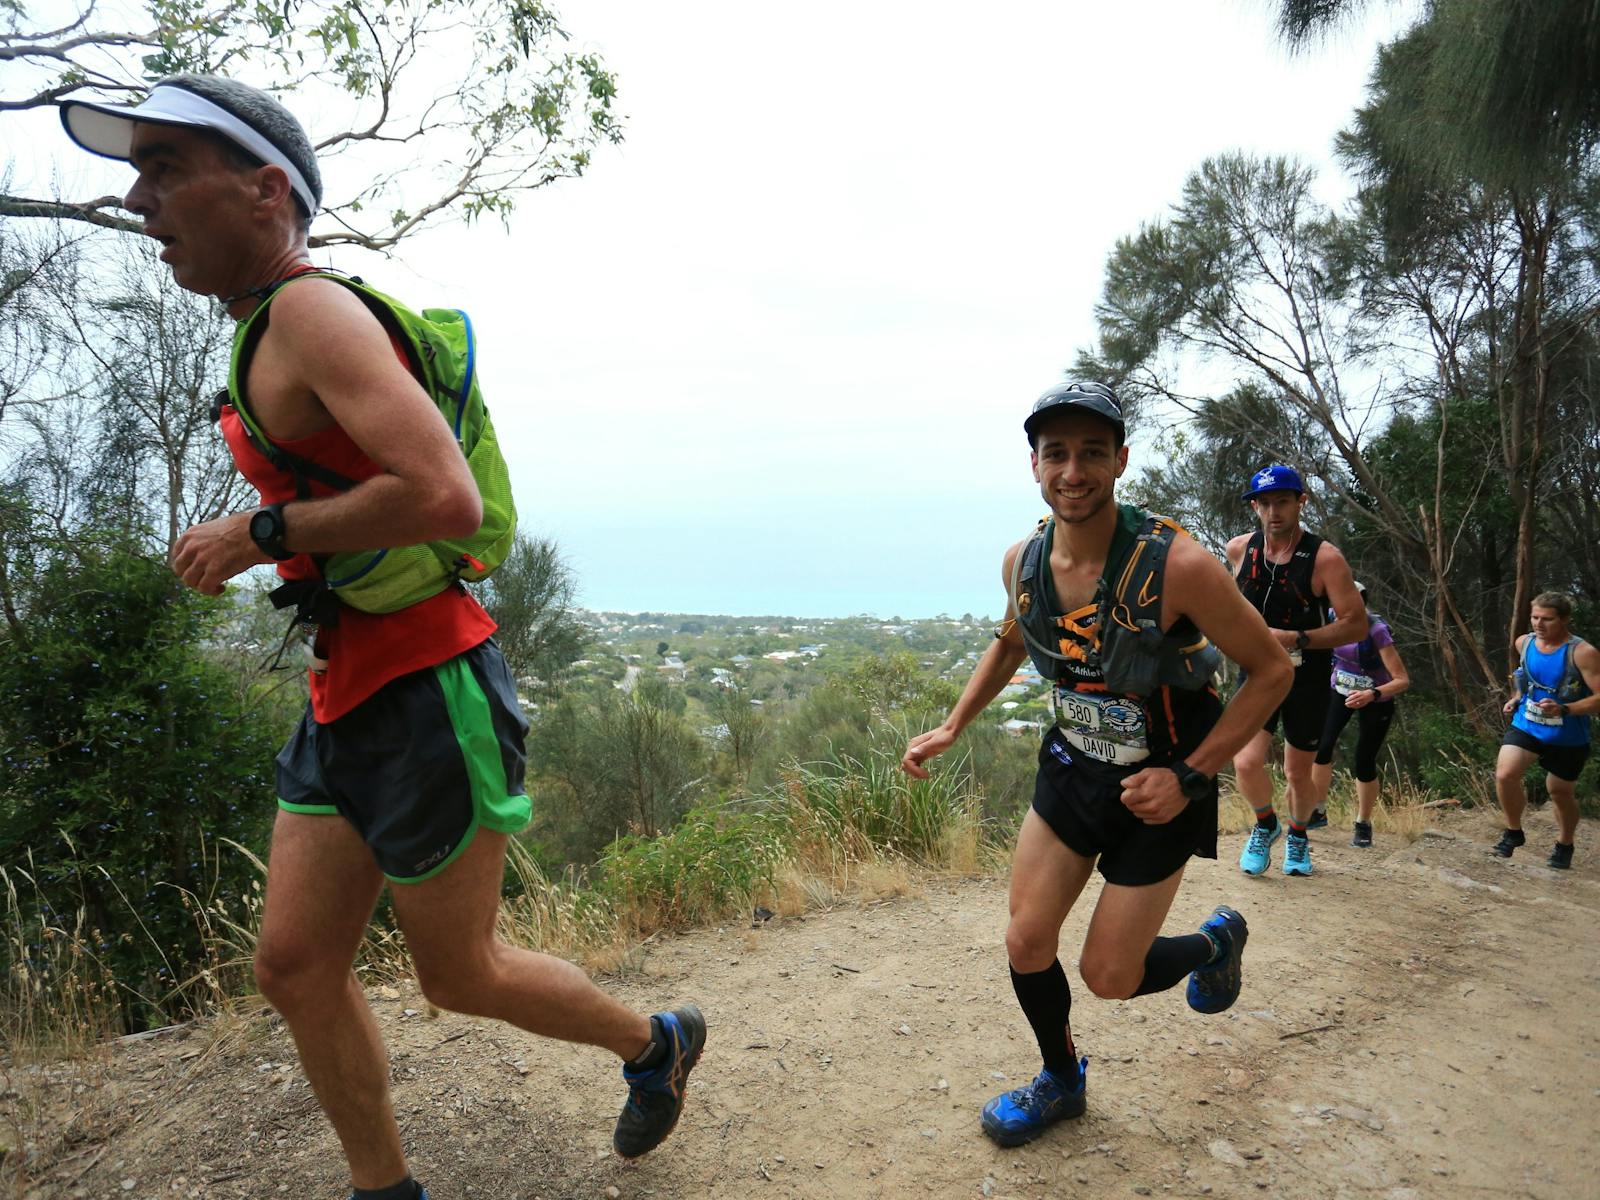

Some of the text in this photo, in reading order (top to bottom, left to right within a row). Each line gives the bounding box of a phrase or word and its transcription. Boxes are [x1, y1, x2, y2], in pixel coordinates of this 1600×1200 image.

[1068, 702, 1092, 723] 580
[1099, 700, 1118, 710] Two
[1124, 721, 1143, 732] Run
[1083, 736, 1116, 759] DAVID
